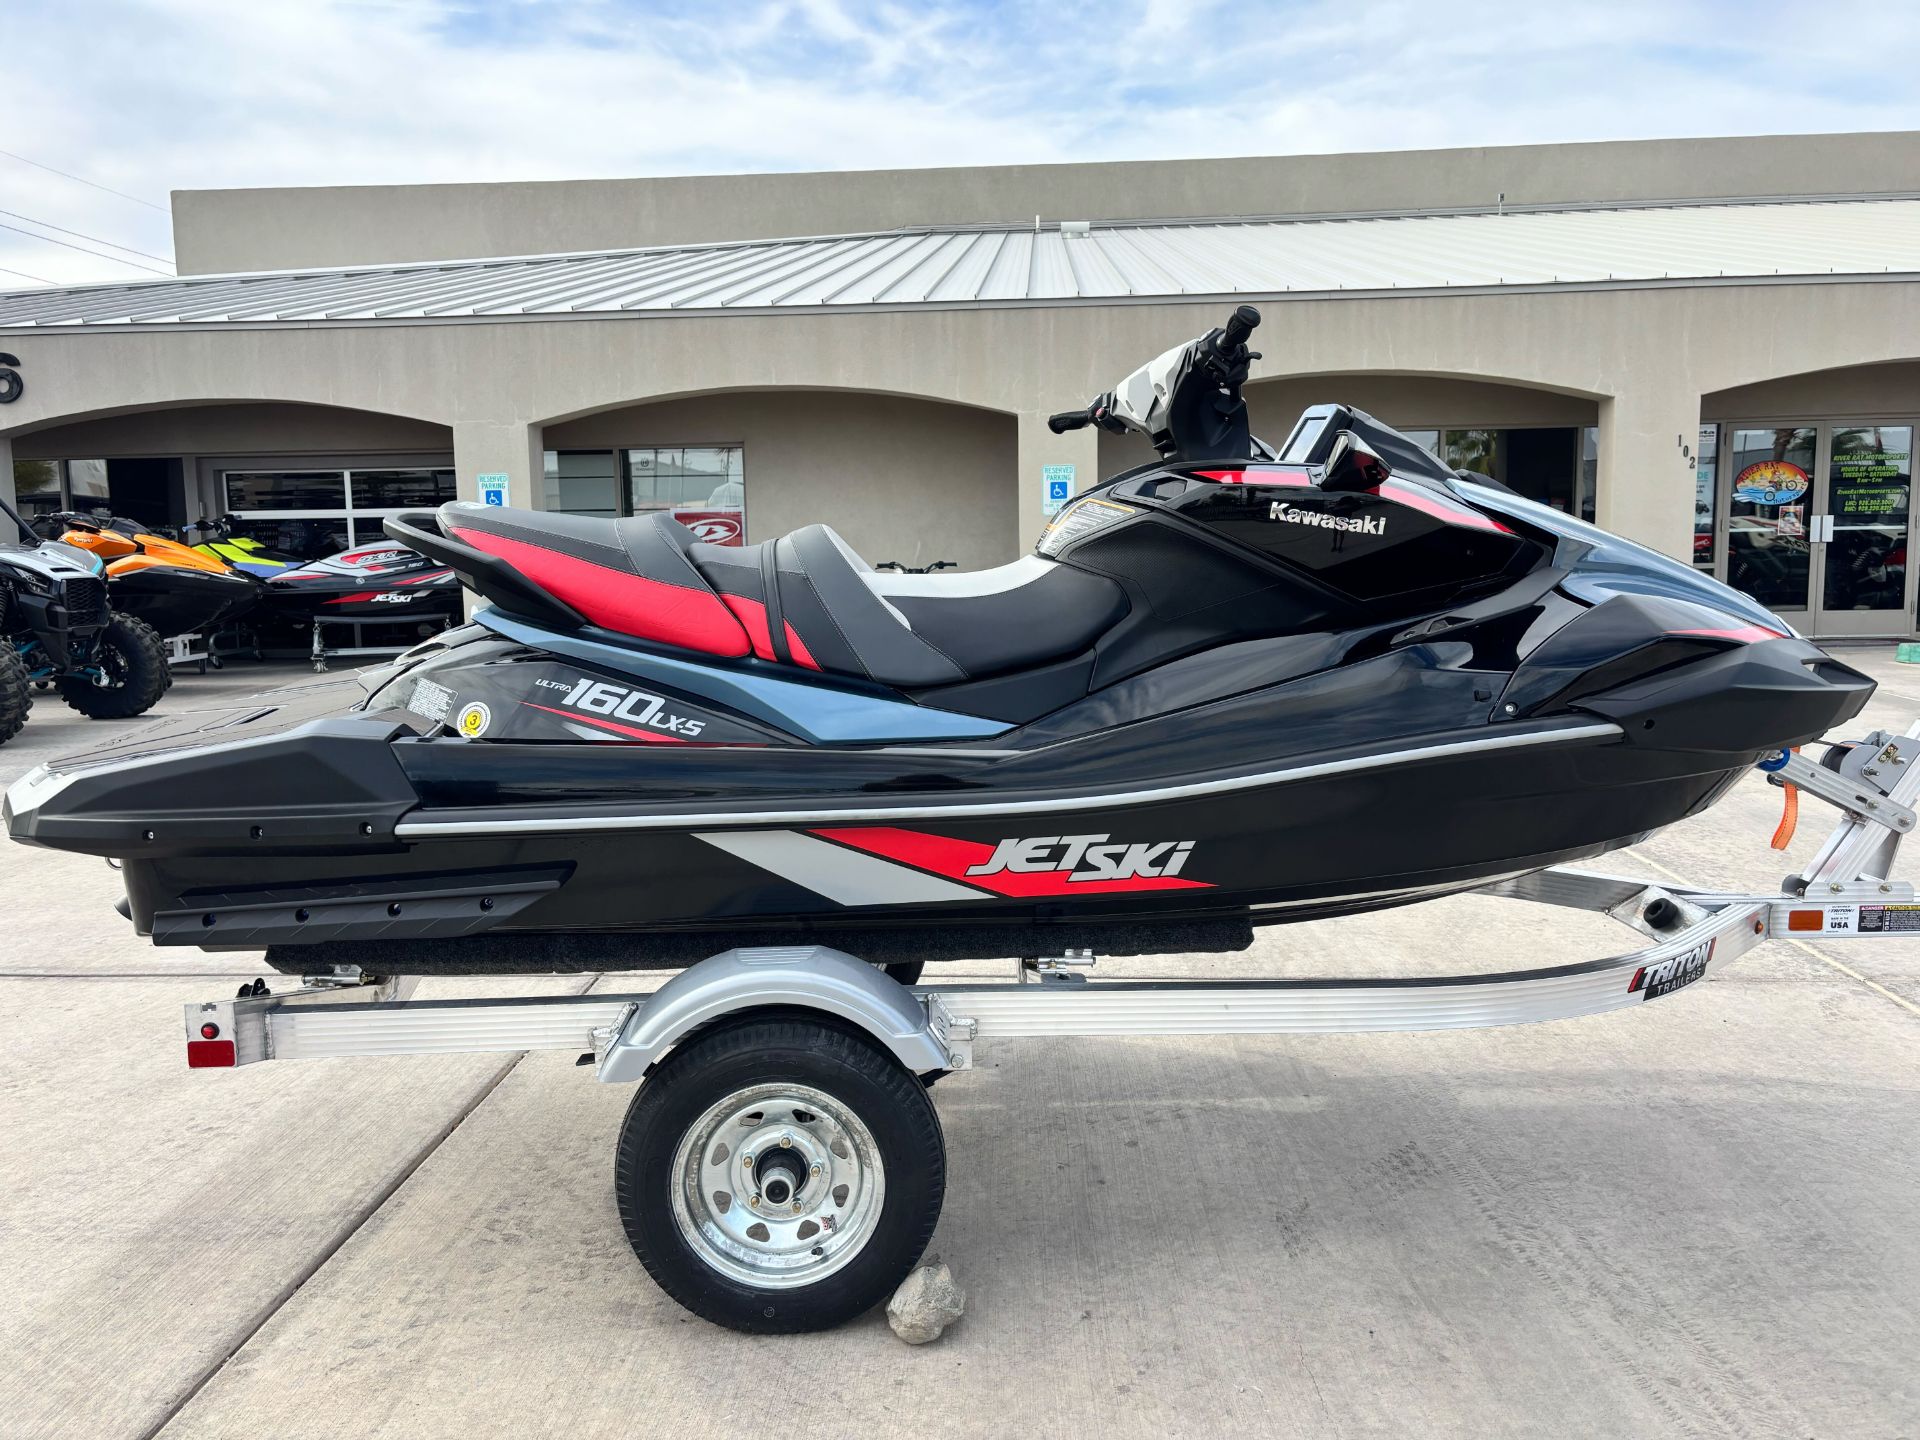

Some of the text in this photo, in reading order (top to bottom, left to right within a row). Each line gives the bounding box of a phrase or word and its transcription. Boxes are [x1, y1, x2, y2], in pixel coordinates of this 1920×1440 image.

[1044, 466, 1074, 474] RESERVED
[1739, 462, 1780, 483] RIVER RAT
[479, 475, 508, 483] RESERVED
[481, 482, 506, 490] PARKING
[1269, 501, 1387, 535] Kawasaki
[535, 678, 572, 693] ULTRA
[469, 714, 478, 726] 3
[1830, 921, 1849, 929] USA
[1641, 940, 1712, 988] TRITON
[1657, 968, 1701, 995] TRAILERS
